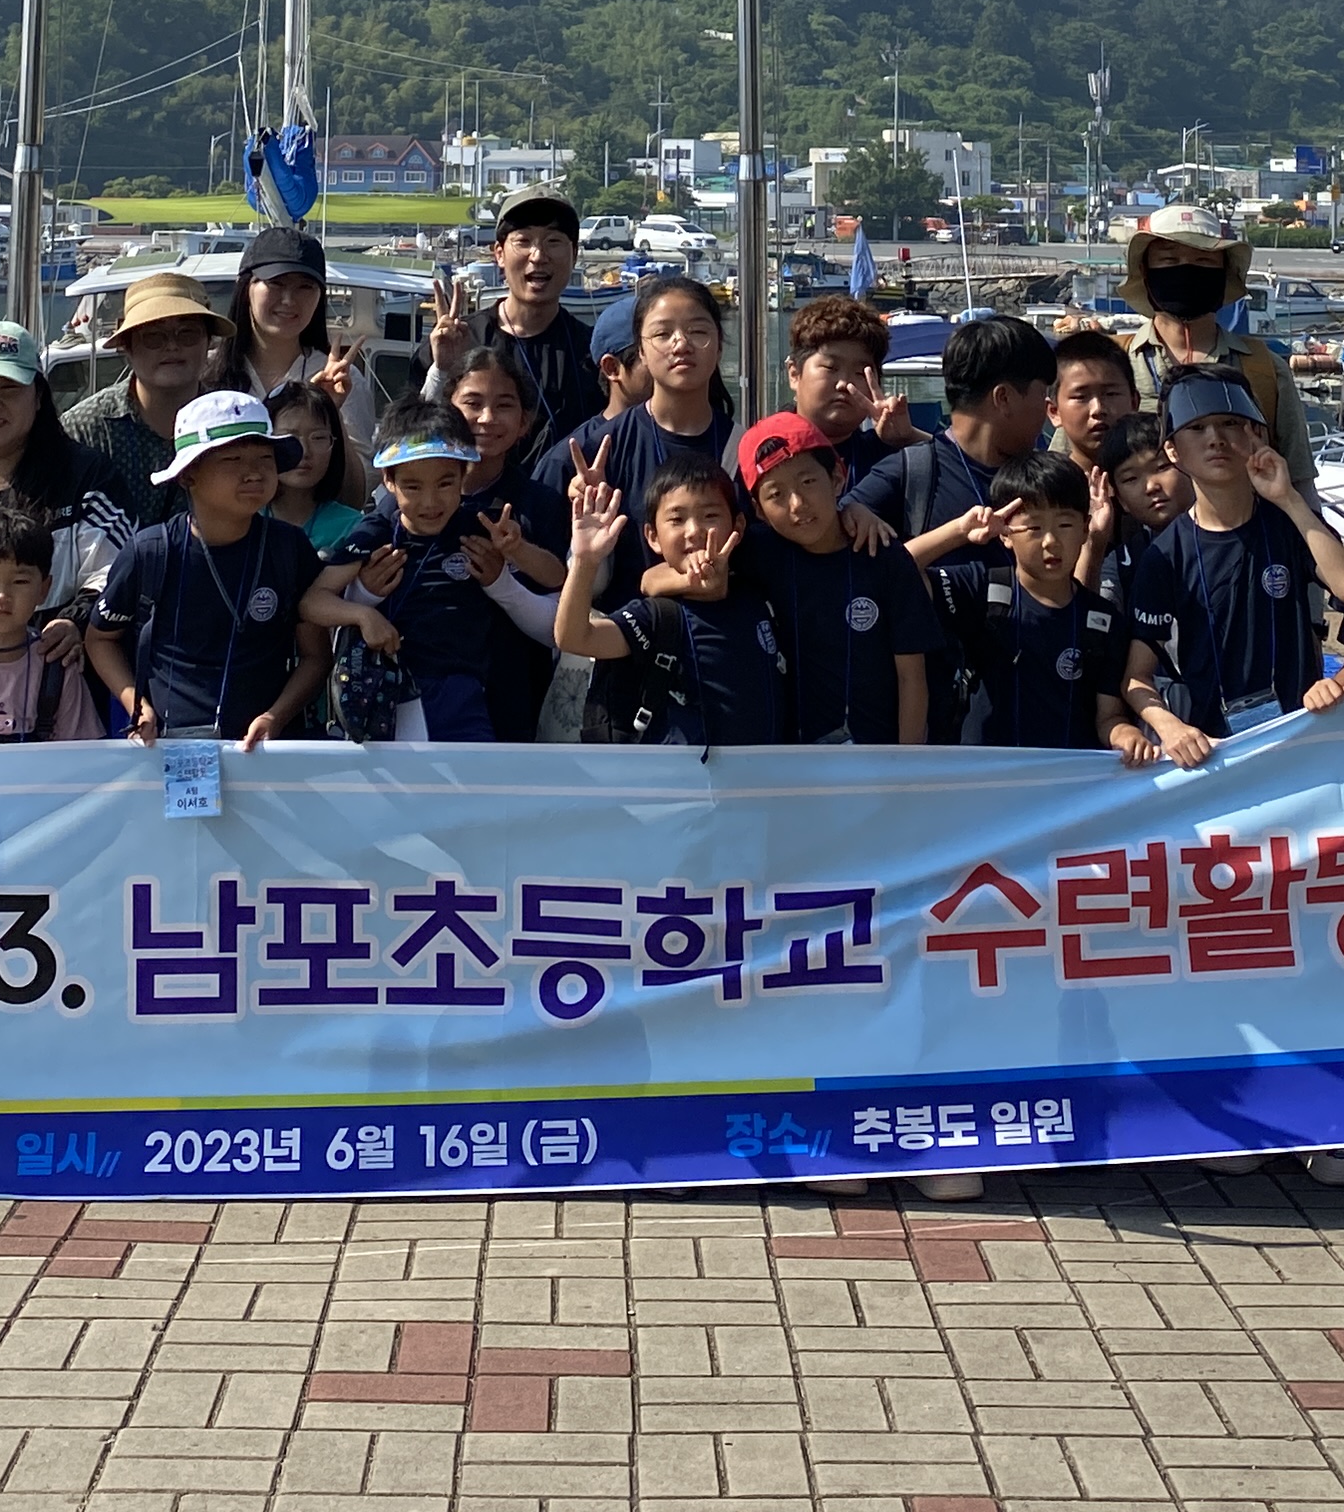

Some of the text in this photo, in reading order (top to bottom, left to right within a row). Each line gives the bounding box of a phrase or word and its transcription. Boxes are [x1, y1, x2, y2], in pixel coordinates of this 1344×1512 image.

[176, 797, 208, 810] 이서호
[130, 882, 881, 1018] 남포초등학교
[851, 1105, 978, 1152] 추봉도
[990, 1097, 1075, 1144] 일원
[144, 1127, 302, 1174] 2023년
[324, 1127, 395, 1170] 6월
